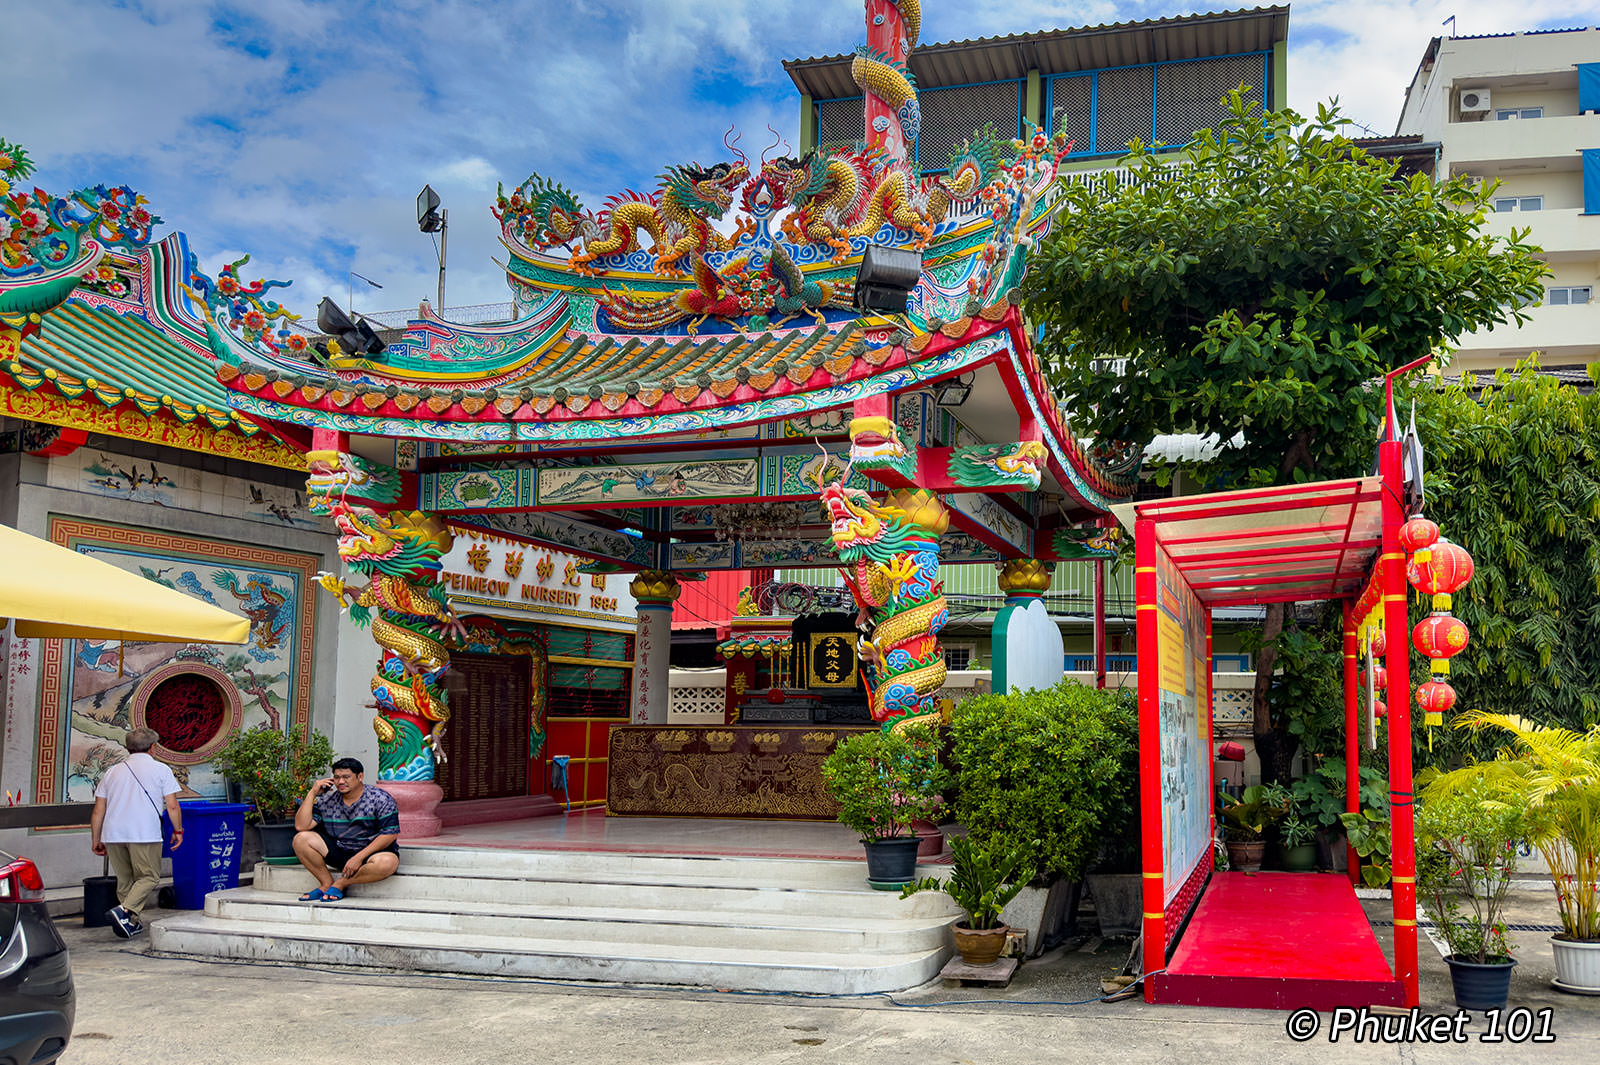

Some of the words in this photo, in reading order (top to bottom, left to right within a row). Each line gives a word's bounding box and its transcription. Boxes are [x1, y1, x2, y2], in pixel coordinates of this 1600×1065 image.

[442, 571, 510, 596] PEIMEOW
[521, 584, 581, 606] NURSERY
[590, 595, 618, 611] 1984
[17, 638, 31, 675] 重修於
[825, 637, 841, 682] 天地父母
